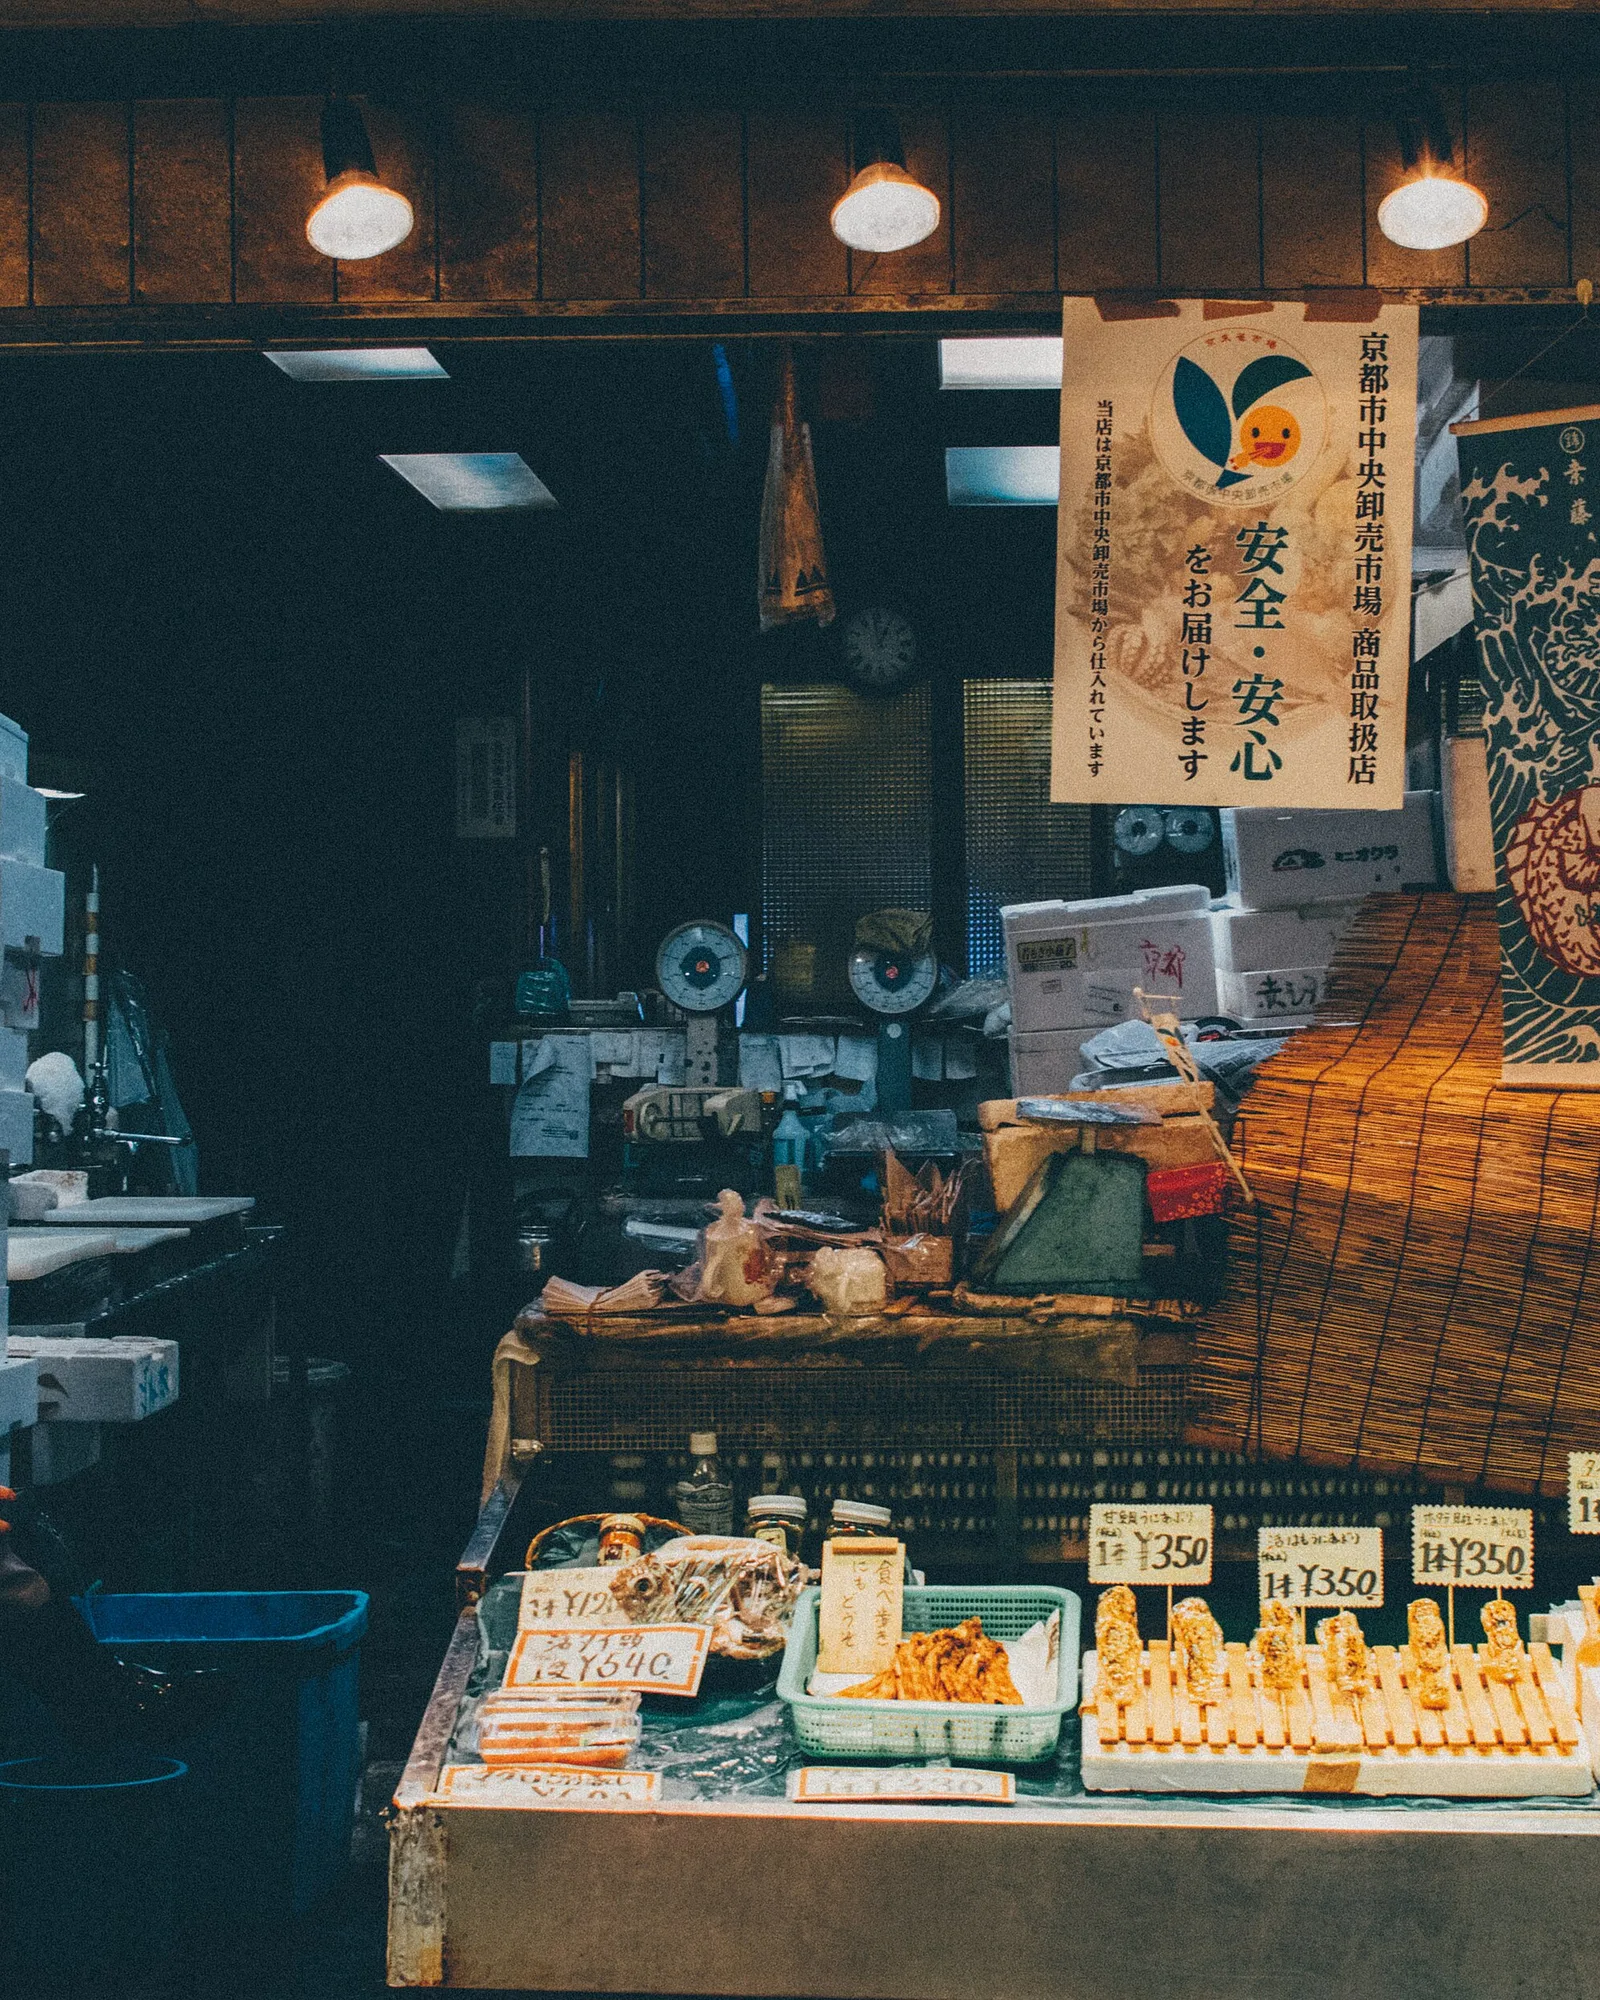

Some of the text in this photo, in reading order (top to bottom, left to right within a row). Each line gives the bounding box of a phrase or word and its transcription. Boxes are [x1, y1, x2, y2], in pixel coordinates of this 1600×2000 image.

[1087, 400, 1114, 779] 当店は京都市中央卸売市場から仕入れています
[1177, 543, 1213, 782] をお届けします
[1229, 521, 1290, 782] 安全・安心
[1346, 331, 1390, 786] 京都市中央卸売市場 商品取扱店
[875, 1559, 894, 1647] 食べ歩き
